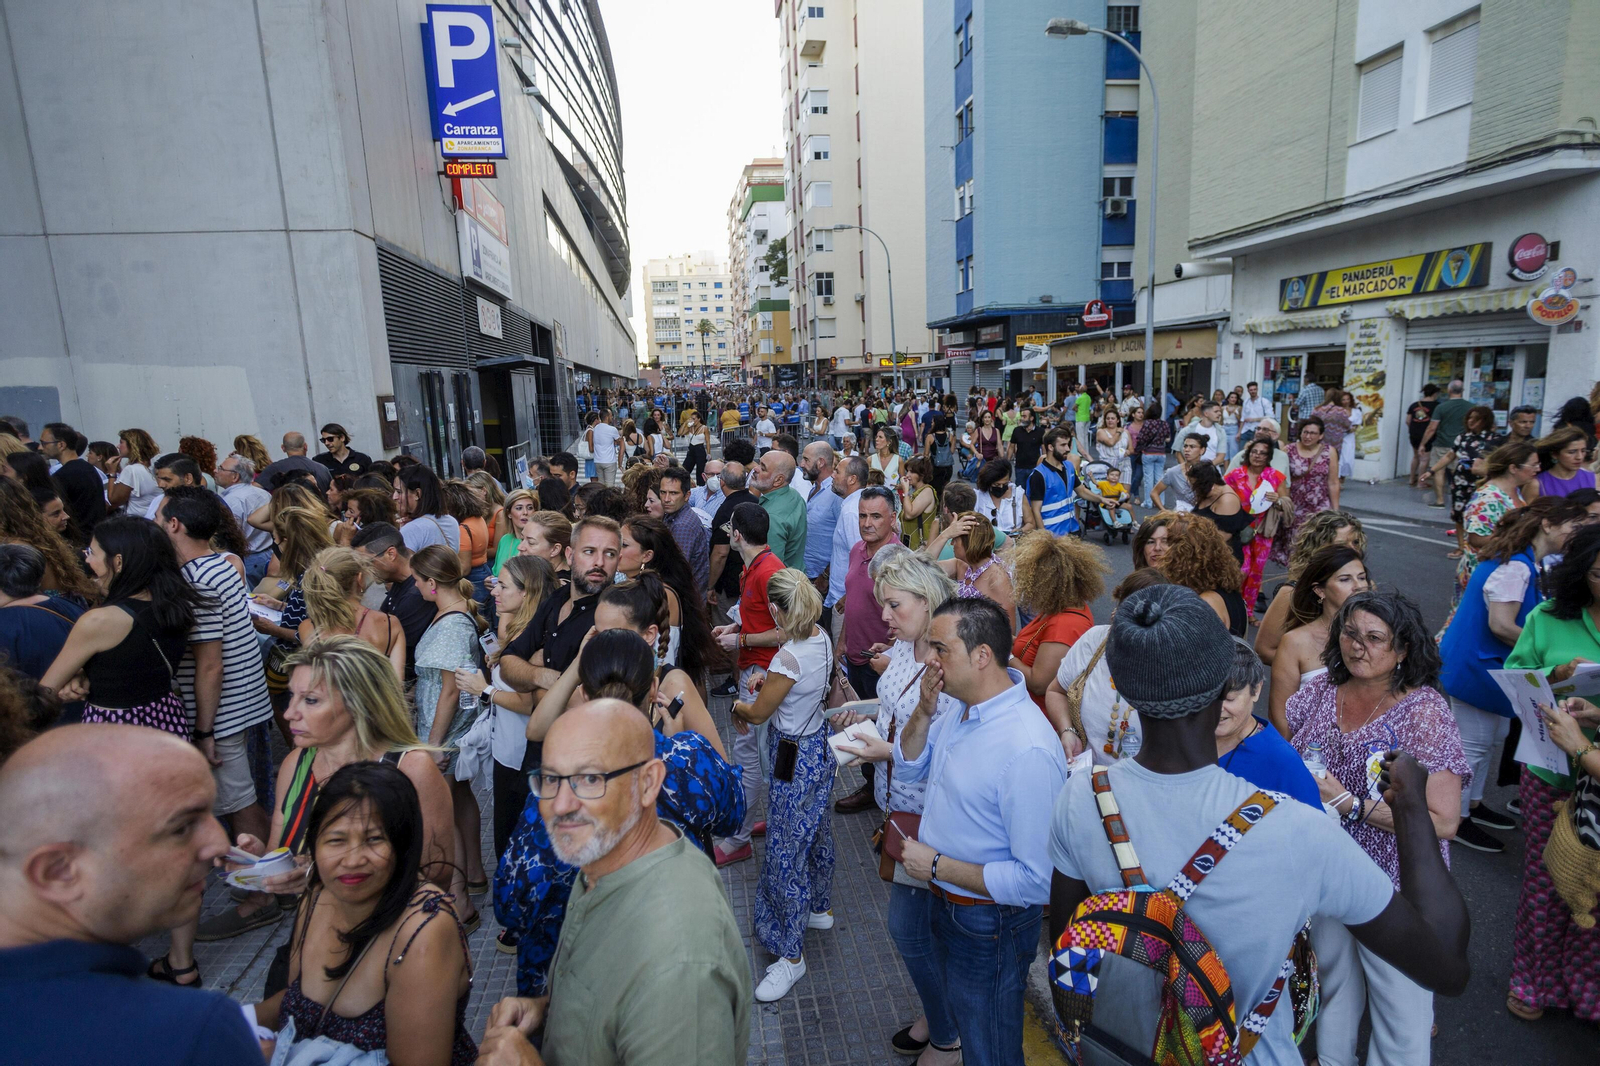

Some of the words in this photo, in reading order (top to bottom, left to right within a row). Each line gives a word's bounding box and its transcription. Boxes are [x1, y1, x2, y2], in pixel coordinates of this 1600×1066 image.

[431, 11, 490, 88] P
[444, 123, 498, 135] Carranza
[446, 163, 494, 175] COMPLETO
[1514, 243, 1546, 262] Coca-Cola
[1342, 262, 1395, 283] PANADERÍA
[1536, 304, 1574, 319] POLVILLO
[1094, 345, 1106, 355] BAR
[1110, 342, 1117, 353] LA
[1121, 340, 1146, 352] LAGUN
